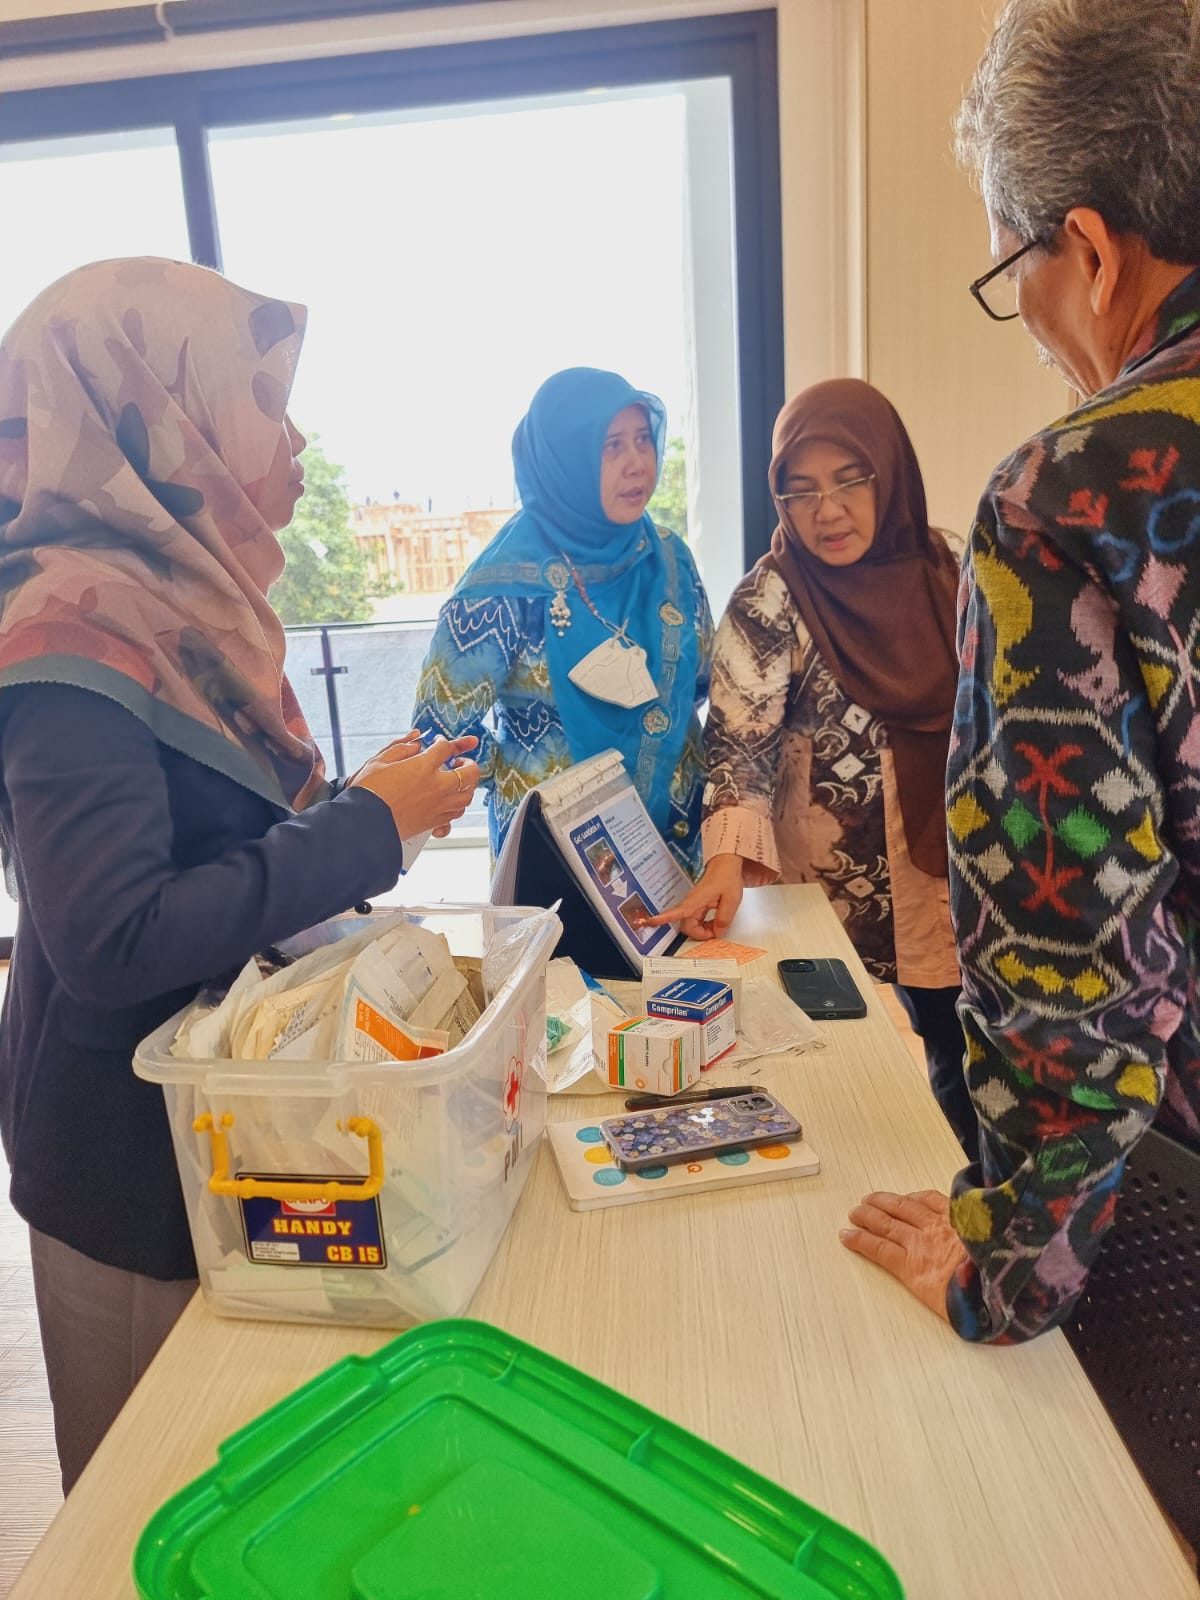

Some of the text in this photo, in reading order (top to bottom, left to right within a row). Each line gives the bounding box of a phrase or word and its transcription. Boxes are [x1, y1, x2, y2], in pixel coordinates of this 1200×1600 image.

[273, 1218, 352, 1236] HANDY
[326, 1245, 380, 1263] CB 15
